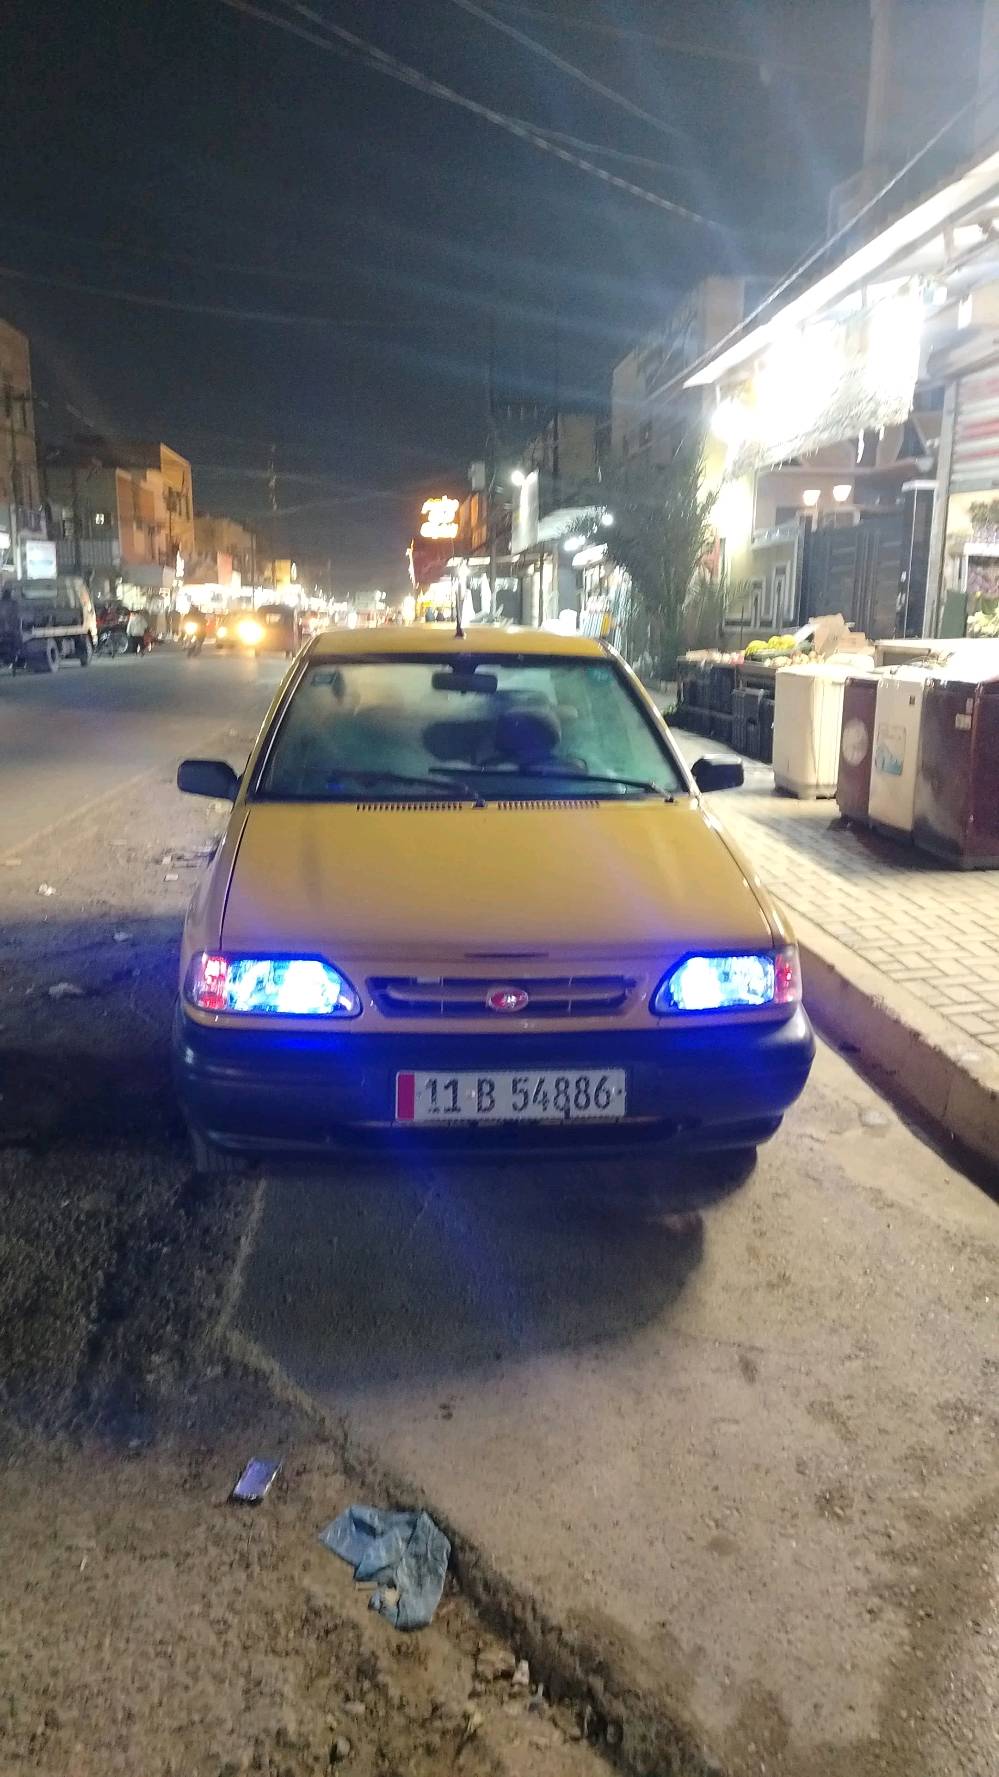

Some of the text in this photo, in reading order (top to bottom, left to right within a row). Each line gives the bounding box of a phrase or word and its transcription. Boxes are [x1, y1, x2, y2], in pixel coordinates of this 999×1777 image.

[425, 1075, 611, 1113] 11 B 54886
